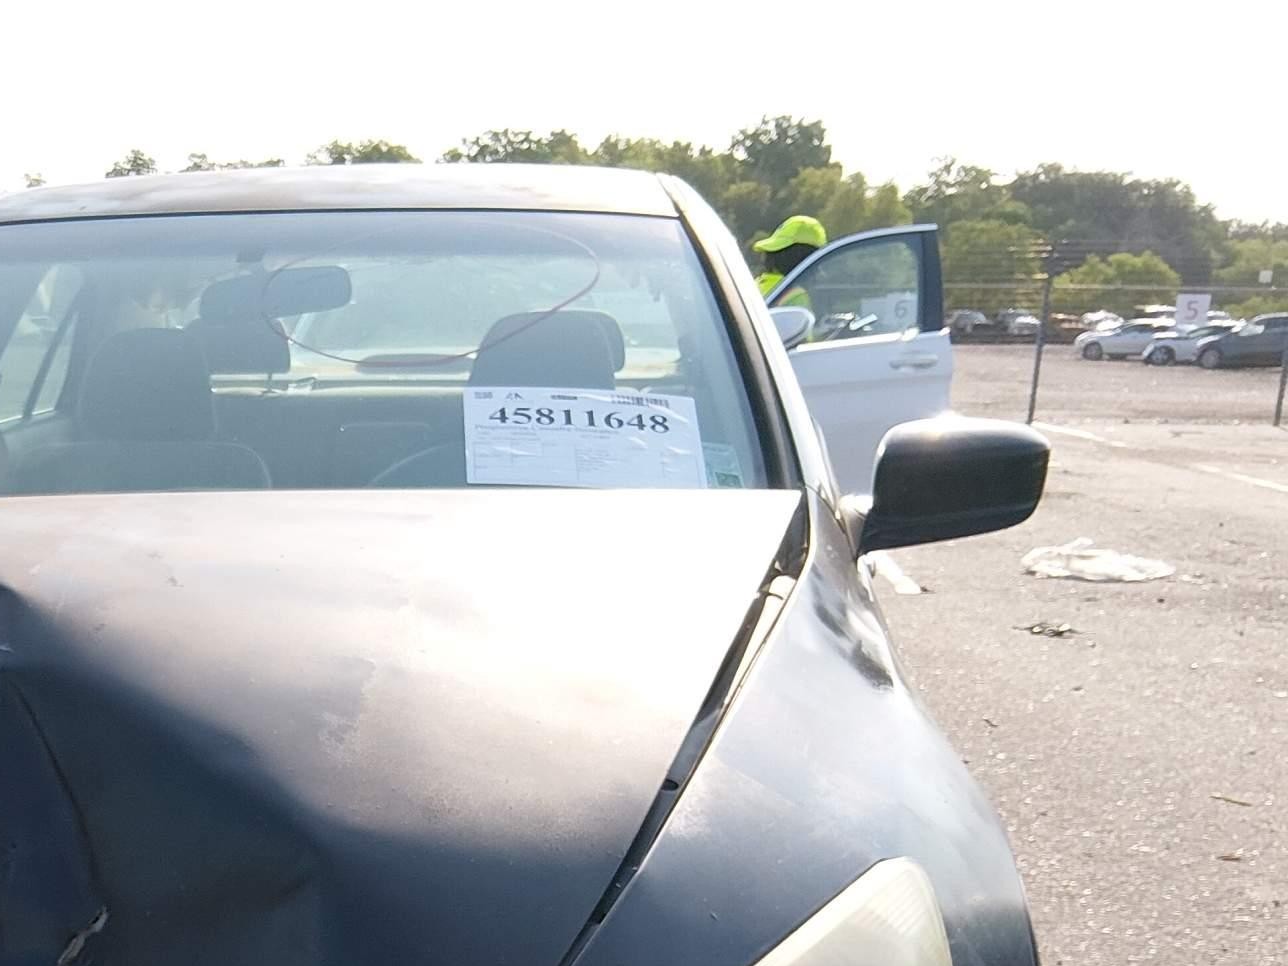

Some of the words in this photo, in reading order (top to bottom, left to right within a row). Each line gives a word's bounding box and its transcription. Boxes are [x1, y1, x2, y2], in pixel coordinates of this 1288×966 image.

[894, 300, 909, 318] 6
[1185, 300, 1199, 320] 5
[489, 406, 670, 434] 45811648
